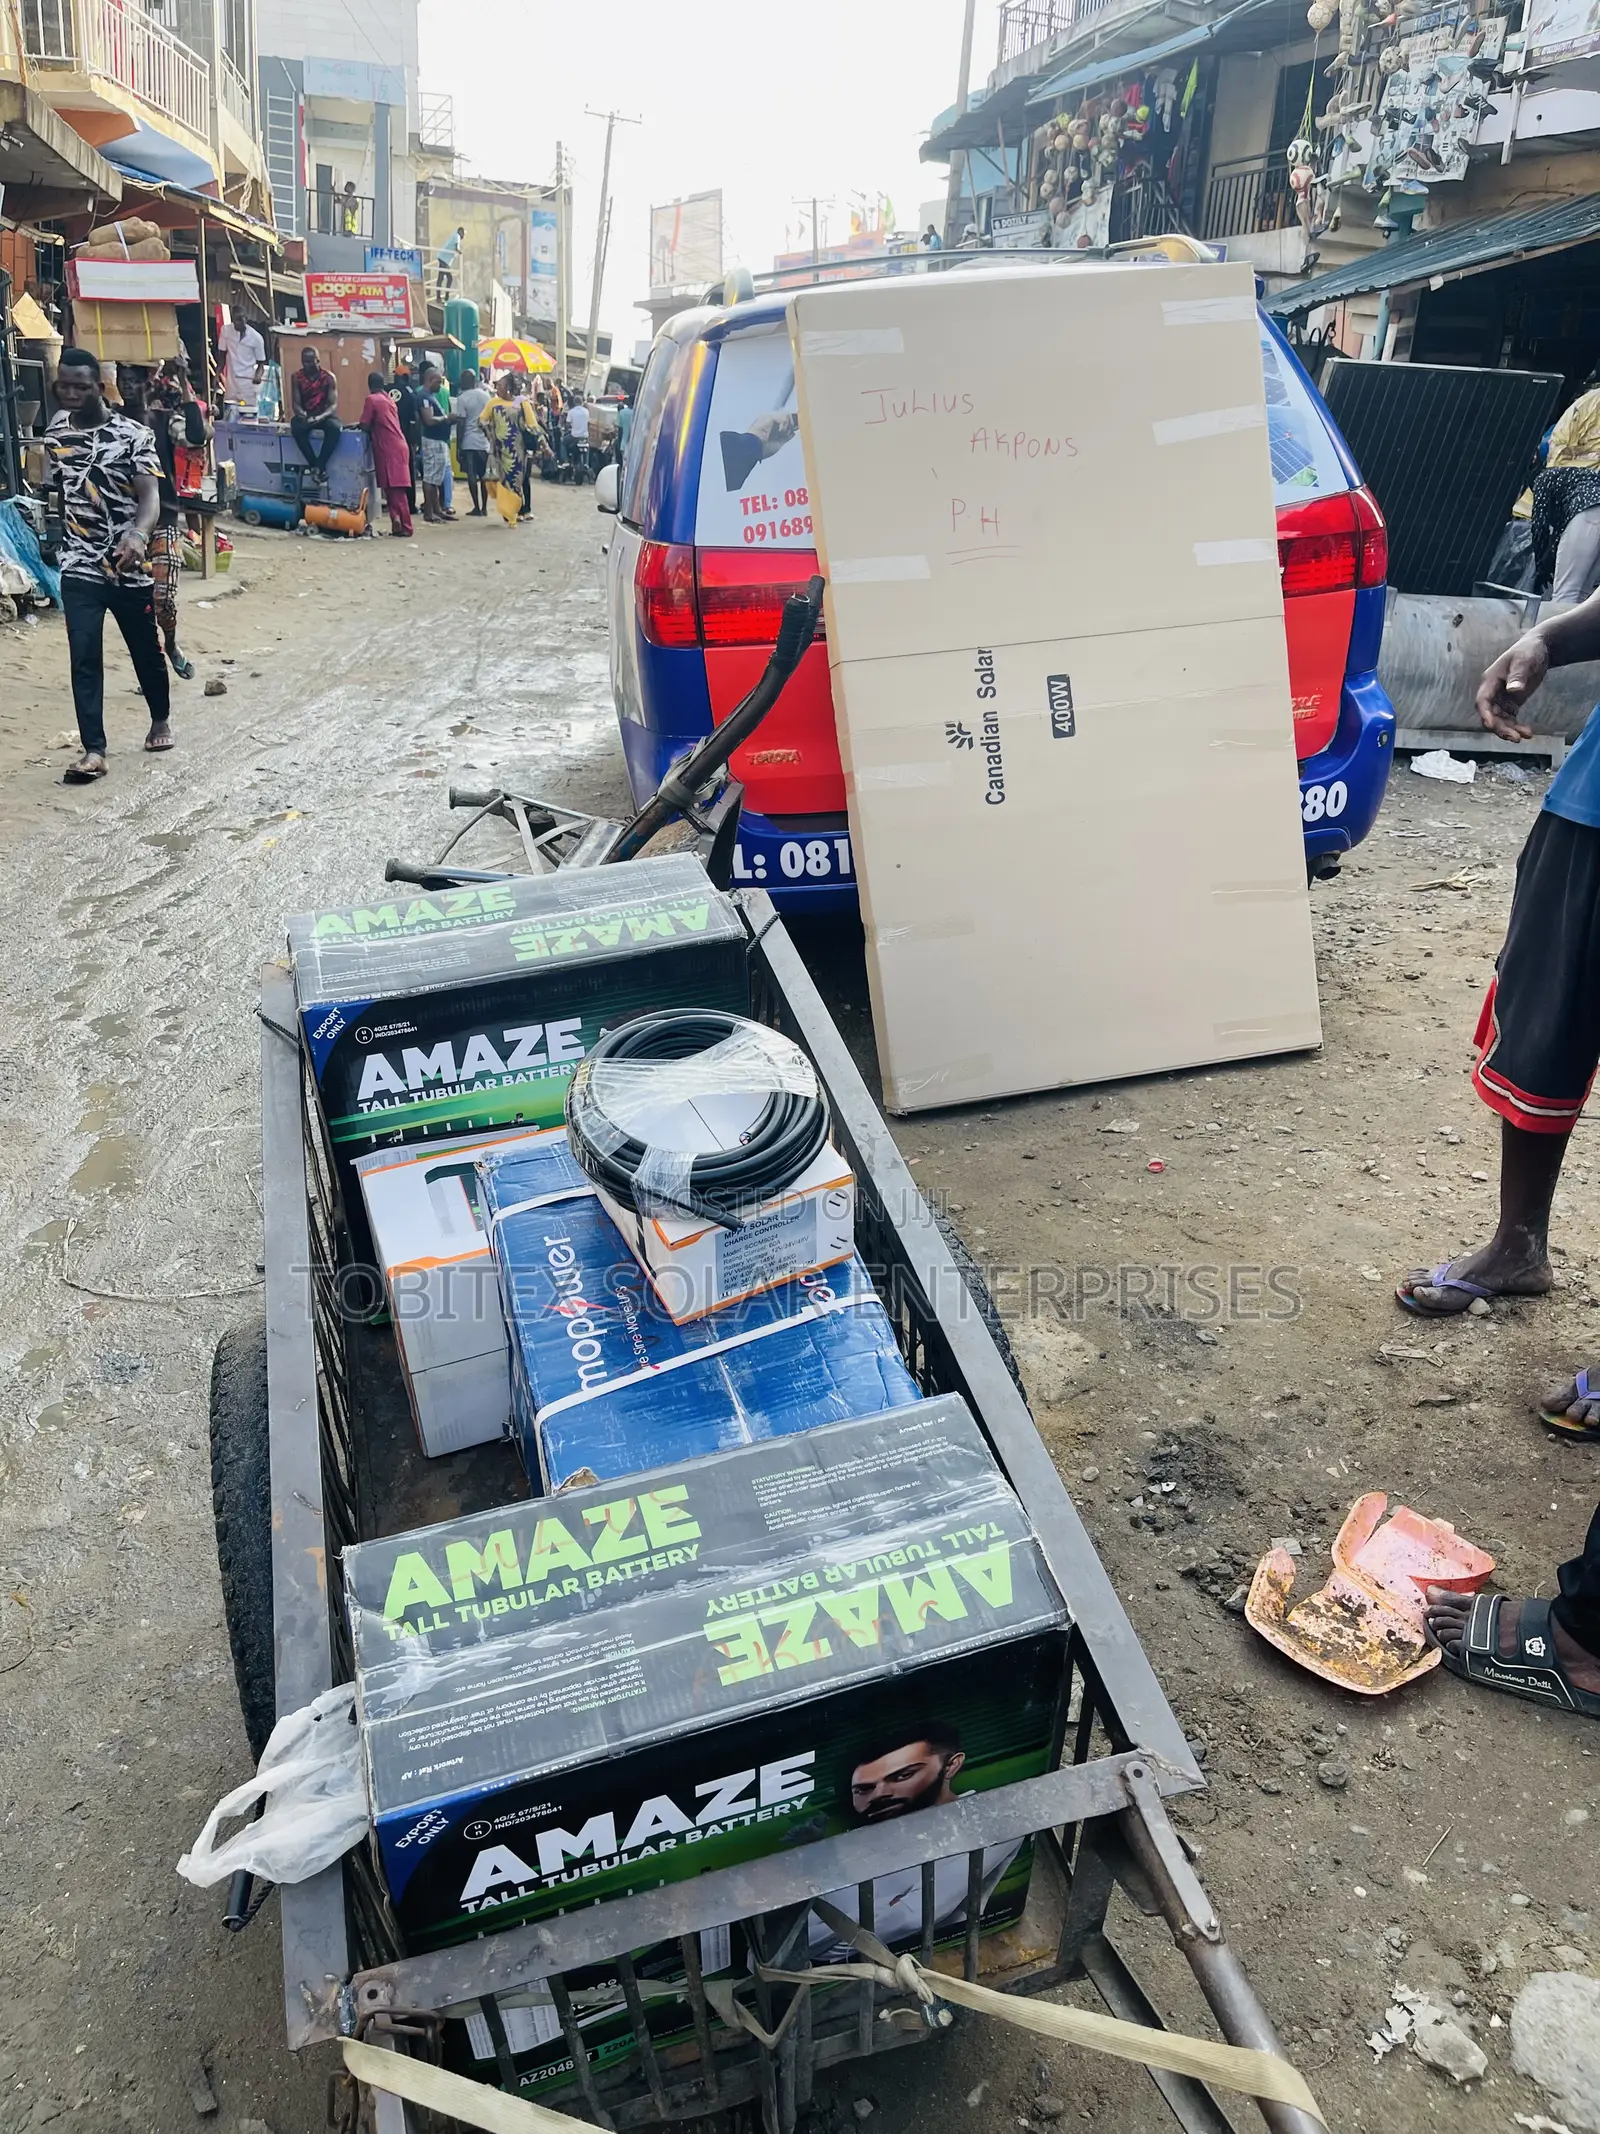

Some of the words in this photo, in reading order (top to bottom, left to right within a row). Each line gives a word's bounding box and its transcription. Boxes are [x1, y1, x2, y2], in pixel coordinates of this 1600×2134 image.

[311, 282, 357, 298] paga
[359, 286, 384, 296] ATM
[861, 388, 974, 424] JULIUS
[739, 494, 778, 516] TEL:
[784, 488, 809, 508] 08
[743, 515, 813, 544] 091689
[973, 646, 997, 699] Solar
[1050, 680, 1072, 733] 400W
[746, 749, 802, 765] TOYOTA
[980, 710, 1006, 805] Canadian
[730, 843, 767, 880] L:
[1299, 780, 1348, 822] 80
[309, 886, 517, 938] AMAZE
[590, 903, 666, 922] TUBULAR
[362, 922, 439, 942] TUBULAR
[440, 909, 515, 929] BATTERY
[509, 903, 710, 962] AMAZE
[511, 915, 586, 934] BATTERY
[313, 1007, 342, 1040] EXPORT
[326, 1017, 347, 1040] ONLY
[356, 1017, 586, 1101] AMAZE
[359, 1096, 406, 1114] TALL
[409, 1077, 498, 1104] TUBULAR
[749, 1215, 779, 1230] SOLAR
[724, 1233, 753, 1247] CHARGE
[754, 1215, 800, 1237] CONTROLLER
[543, 1235, 608, 1392] mopower
[624, 1305, 640, 1334] Wave
[941, 1521, 1004, 1550] TALL
[383, 1484, 702, 1622] AMAZE
[823, 1540, 941, 1585] TUBULAR
[383, 1611, 450, 1641] TALL
[455, 1577, 582, 1622] TUBULAR
[586, 1543, 701, 1590] BATTERY
[706, 1571, 819, 1617] BATTERY
[703, 1539, 1014, 1687] AMAZE
[614, 1632, 632, 1642] Avoid
[617, 1637, 634, 1648] Keep
[542, 1652, 563, 1663] across
[564, 1644, 589, 1657] contact
[583, 1648, 599, 1658] from
[537, 1659, 559, 1671] lighted
[608, 1663, 641, 1678] registered
[466, 1679, 486, 1691] flame
[599, 1679, 617, 1689] other
[617, 1672, 643, 1683] manner
[538, 1691, 547, 1699] by
[583, 1685, 598, 1693] than
[589, 1691, 598, 1699] by
[598, 1682, 633, 1697] mandated
[605, 1686, 647, 1703] STATUTORY
[494, 1697, 525, 1711] company
[526, 1694, 537, 1702] the
[536, 1699, 548, 1707] the
[562, 1699, 577, 1707] that
[569, 1698, 606, 1714] WARNING:
[501, 1708, 516, 1717] with
[516, 1702, 535, 1712] same
[545, 1703, 562, 1712] used
[430, 1713, 469, 1729] designated
[488, 1713, 500, 1721] the
[495, 1717, 513, 1726] must
[397, 1724, 430, 1738] collection
[416, 1723, 464, 1742] manufacturer
[482, 1722, 495, 1730] not
[429, 1738, 440, 1746] off
[440, 1728, 472, 1742] disposed
[406, 1742, 421, 1751] any
[433, 1756, 464, 1771] Artwork
[401, 1771, 413, 1780] AP
[493, 1813, 517, 1824] 4G/Z
[518, 1802, 552, 1817] 67/S/21
[395, 1808, 443, 1849] EXPORT
[417, 1816, 450, 1845] ONLY
[459, 1750, 815, 1902] AMAZE
[461, 1886, 536, 1914] TALL
[541, 1838, 678, 1888] TUBULAR
[685, 1796, 809, 1845] BATTERY
